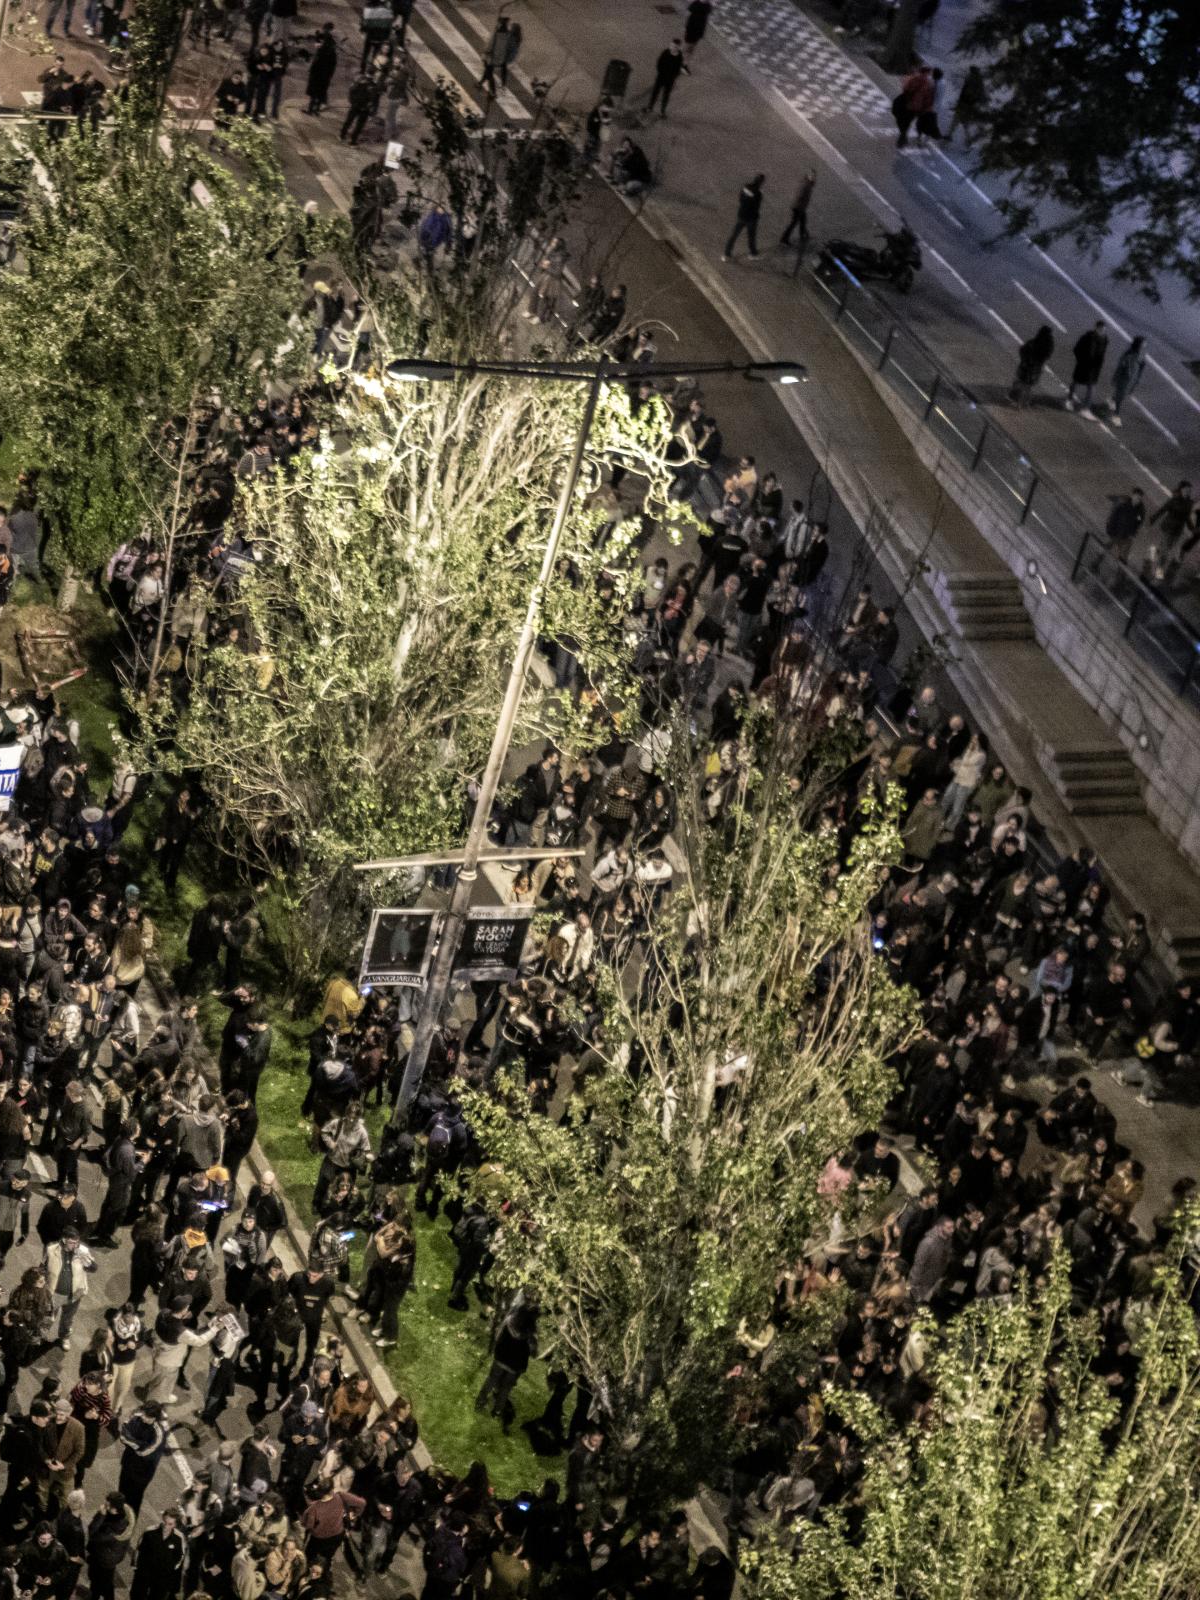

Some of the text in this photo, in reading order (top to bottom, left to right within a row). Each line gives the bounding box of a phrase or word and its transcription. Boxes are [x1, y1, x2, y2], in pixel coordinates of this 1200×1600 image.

[477, 925, 515, 935] SARAH
[475, 933, 513, 941] MOON
[372, 975, 422, 984] VANGUARDIA
